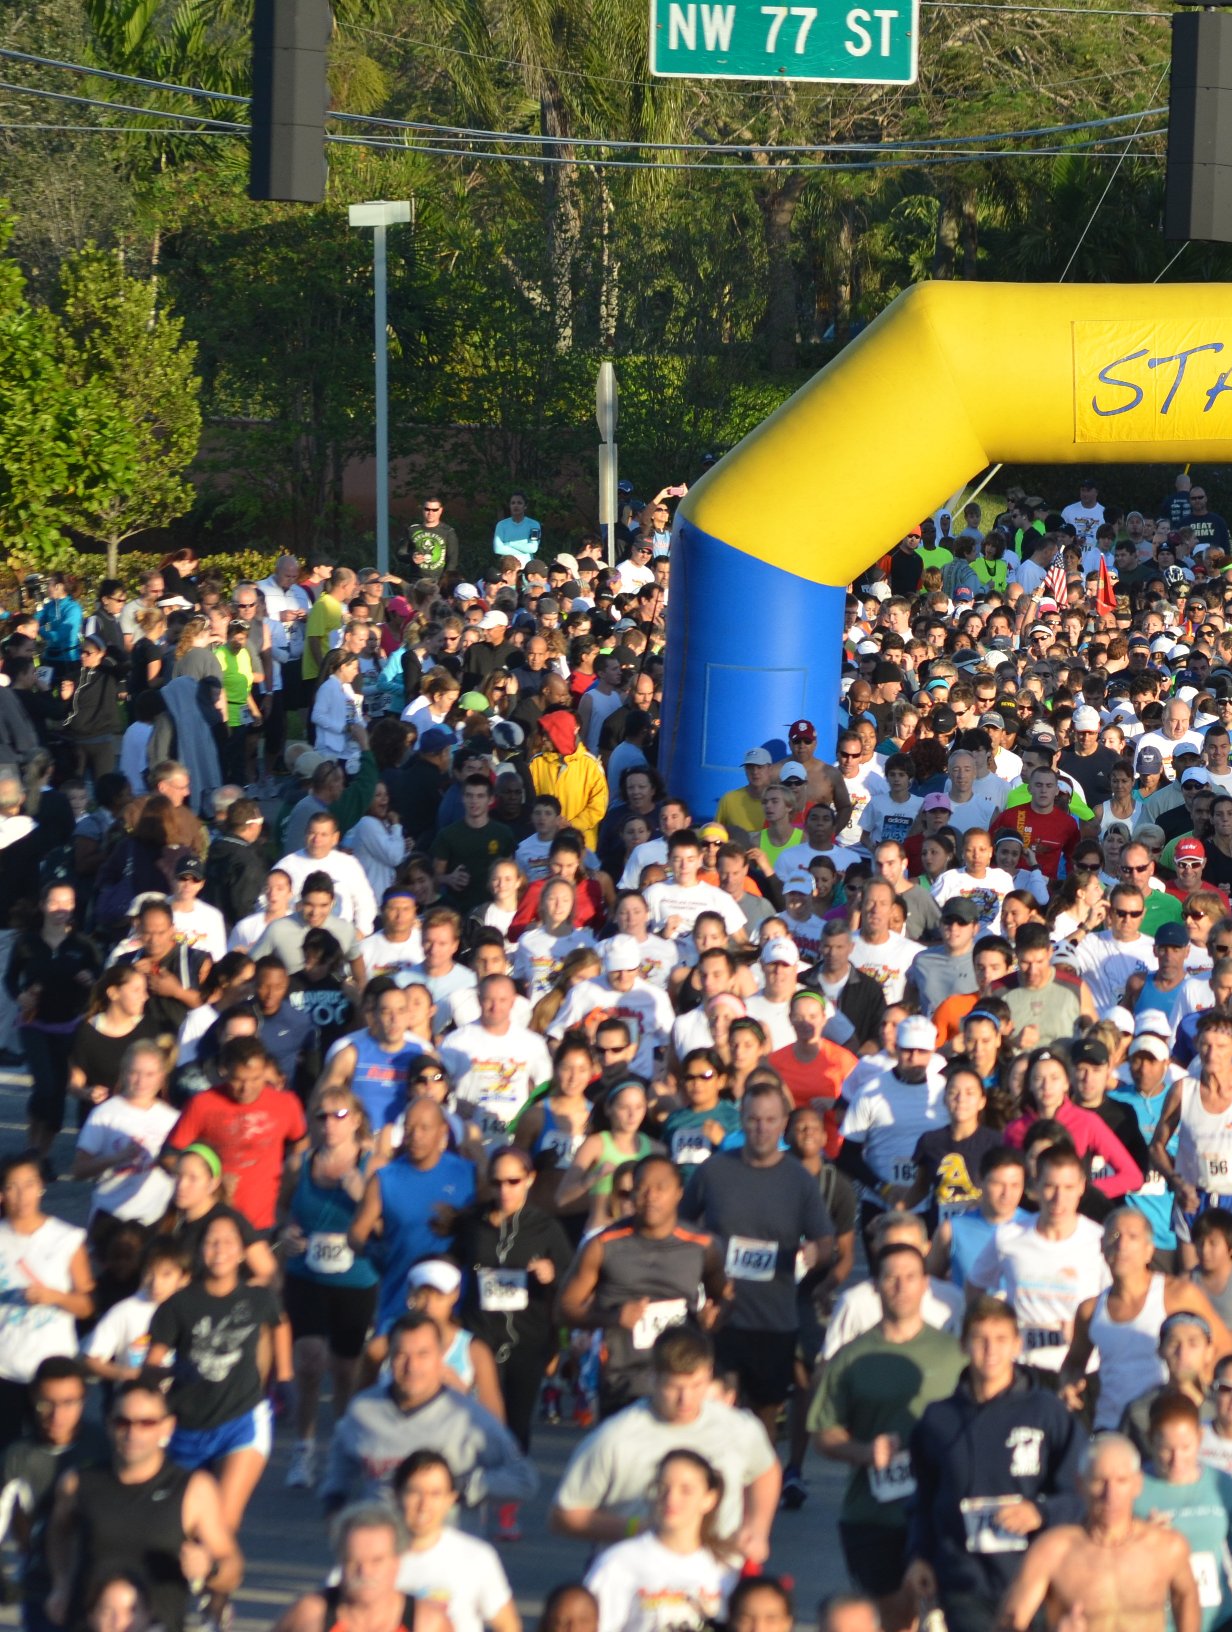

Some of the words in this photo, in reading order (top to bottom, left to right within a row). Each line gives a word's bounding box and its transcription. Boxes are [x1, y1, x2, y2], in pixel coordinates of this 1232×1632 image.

[668, 3, 736, 51] NW
[761, 6, 818, 54] 77
[845, 8, 899, 57] ST
[1193, 529, 1215, 537] RMY
[1208, 1160, 1229, 1176] 56
